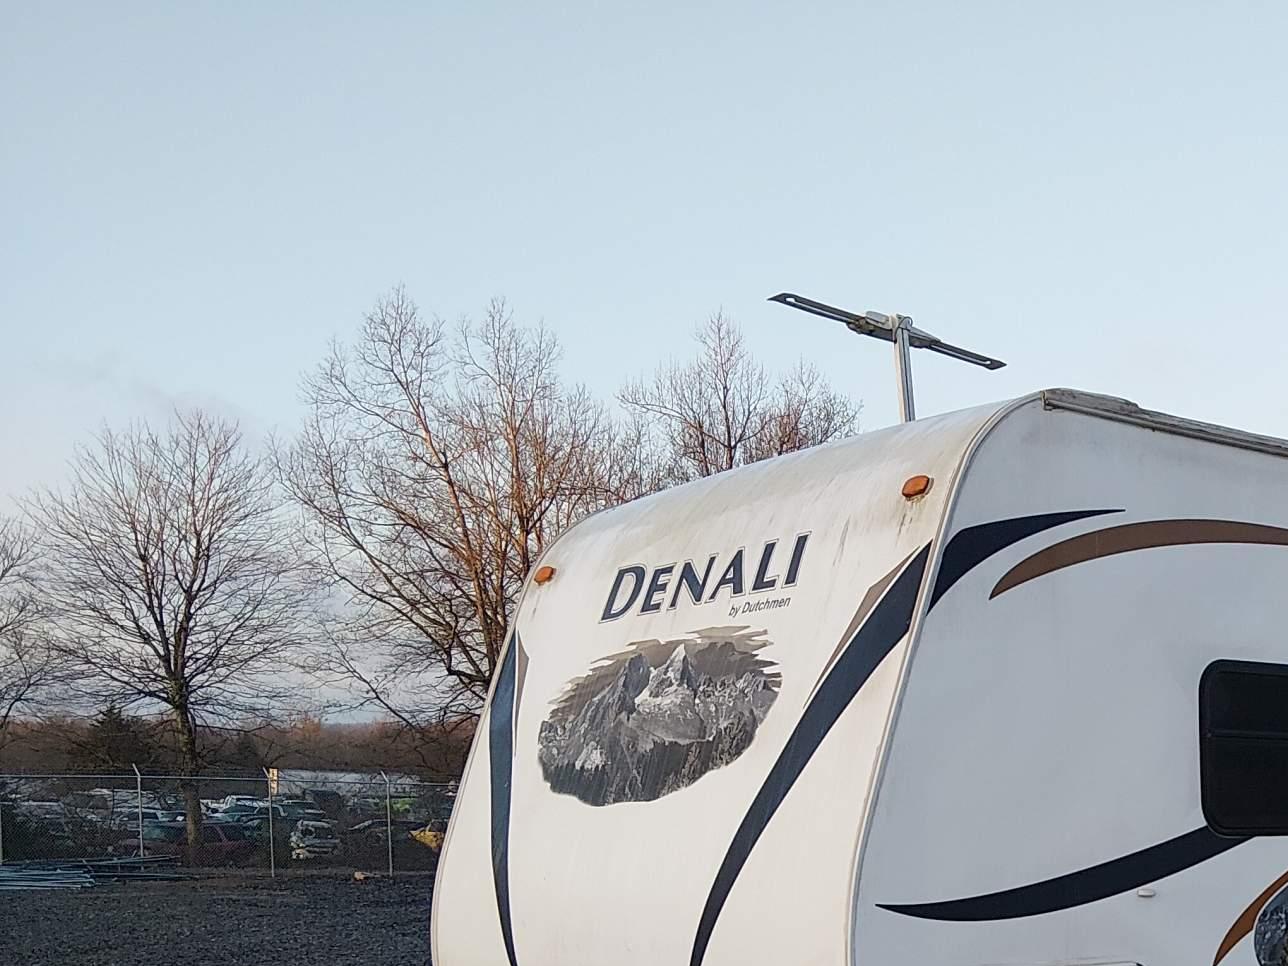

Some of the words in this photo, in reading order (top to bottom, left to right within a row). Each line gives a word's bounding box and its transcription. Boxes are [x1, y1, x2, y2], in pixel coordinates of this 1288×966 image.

[598, 531, 812, 624] DENALI
[728, 604, 741, 618] by
[742, 596, 792, 615] Dutchmen
